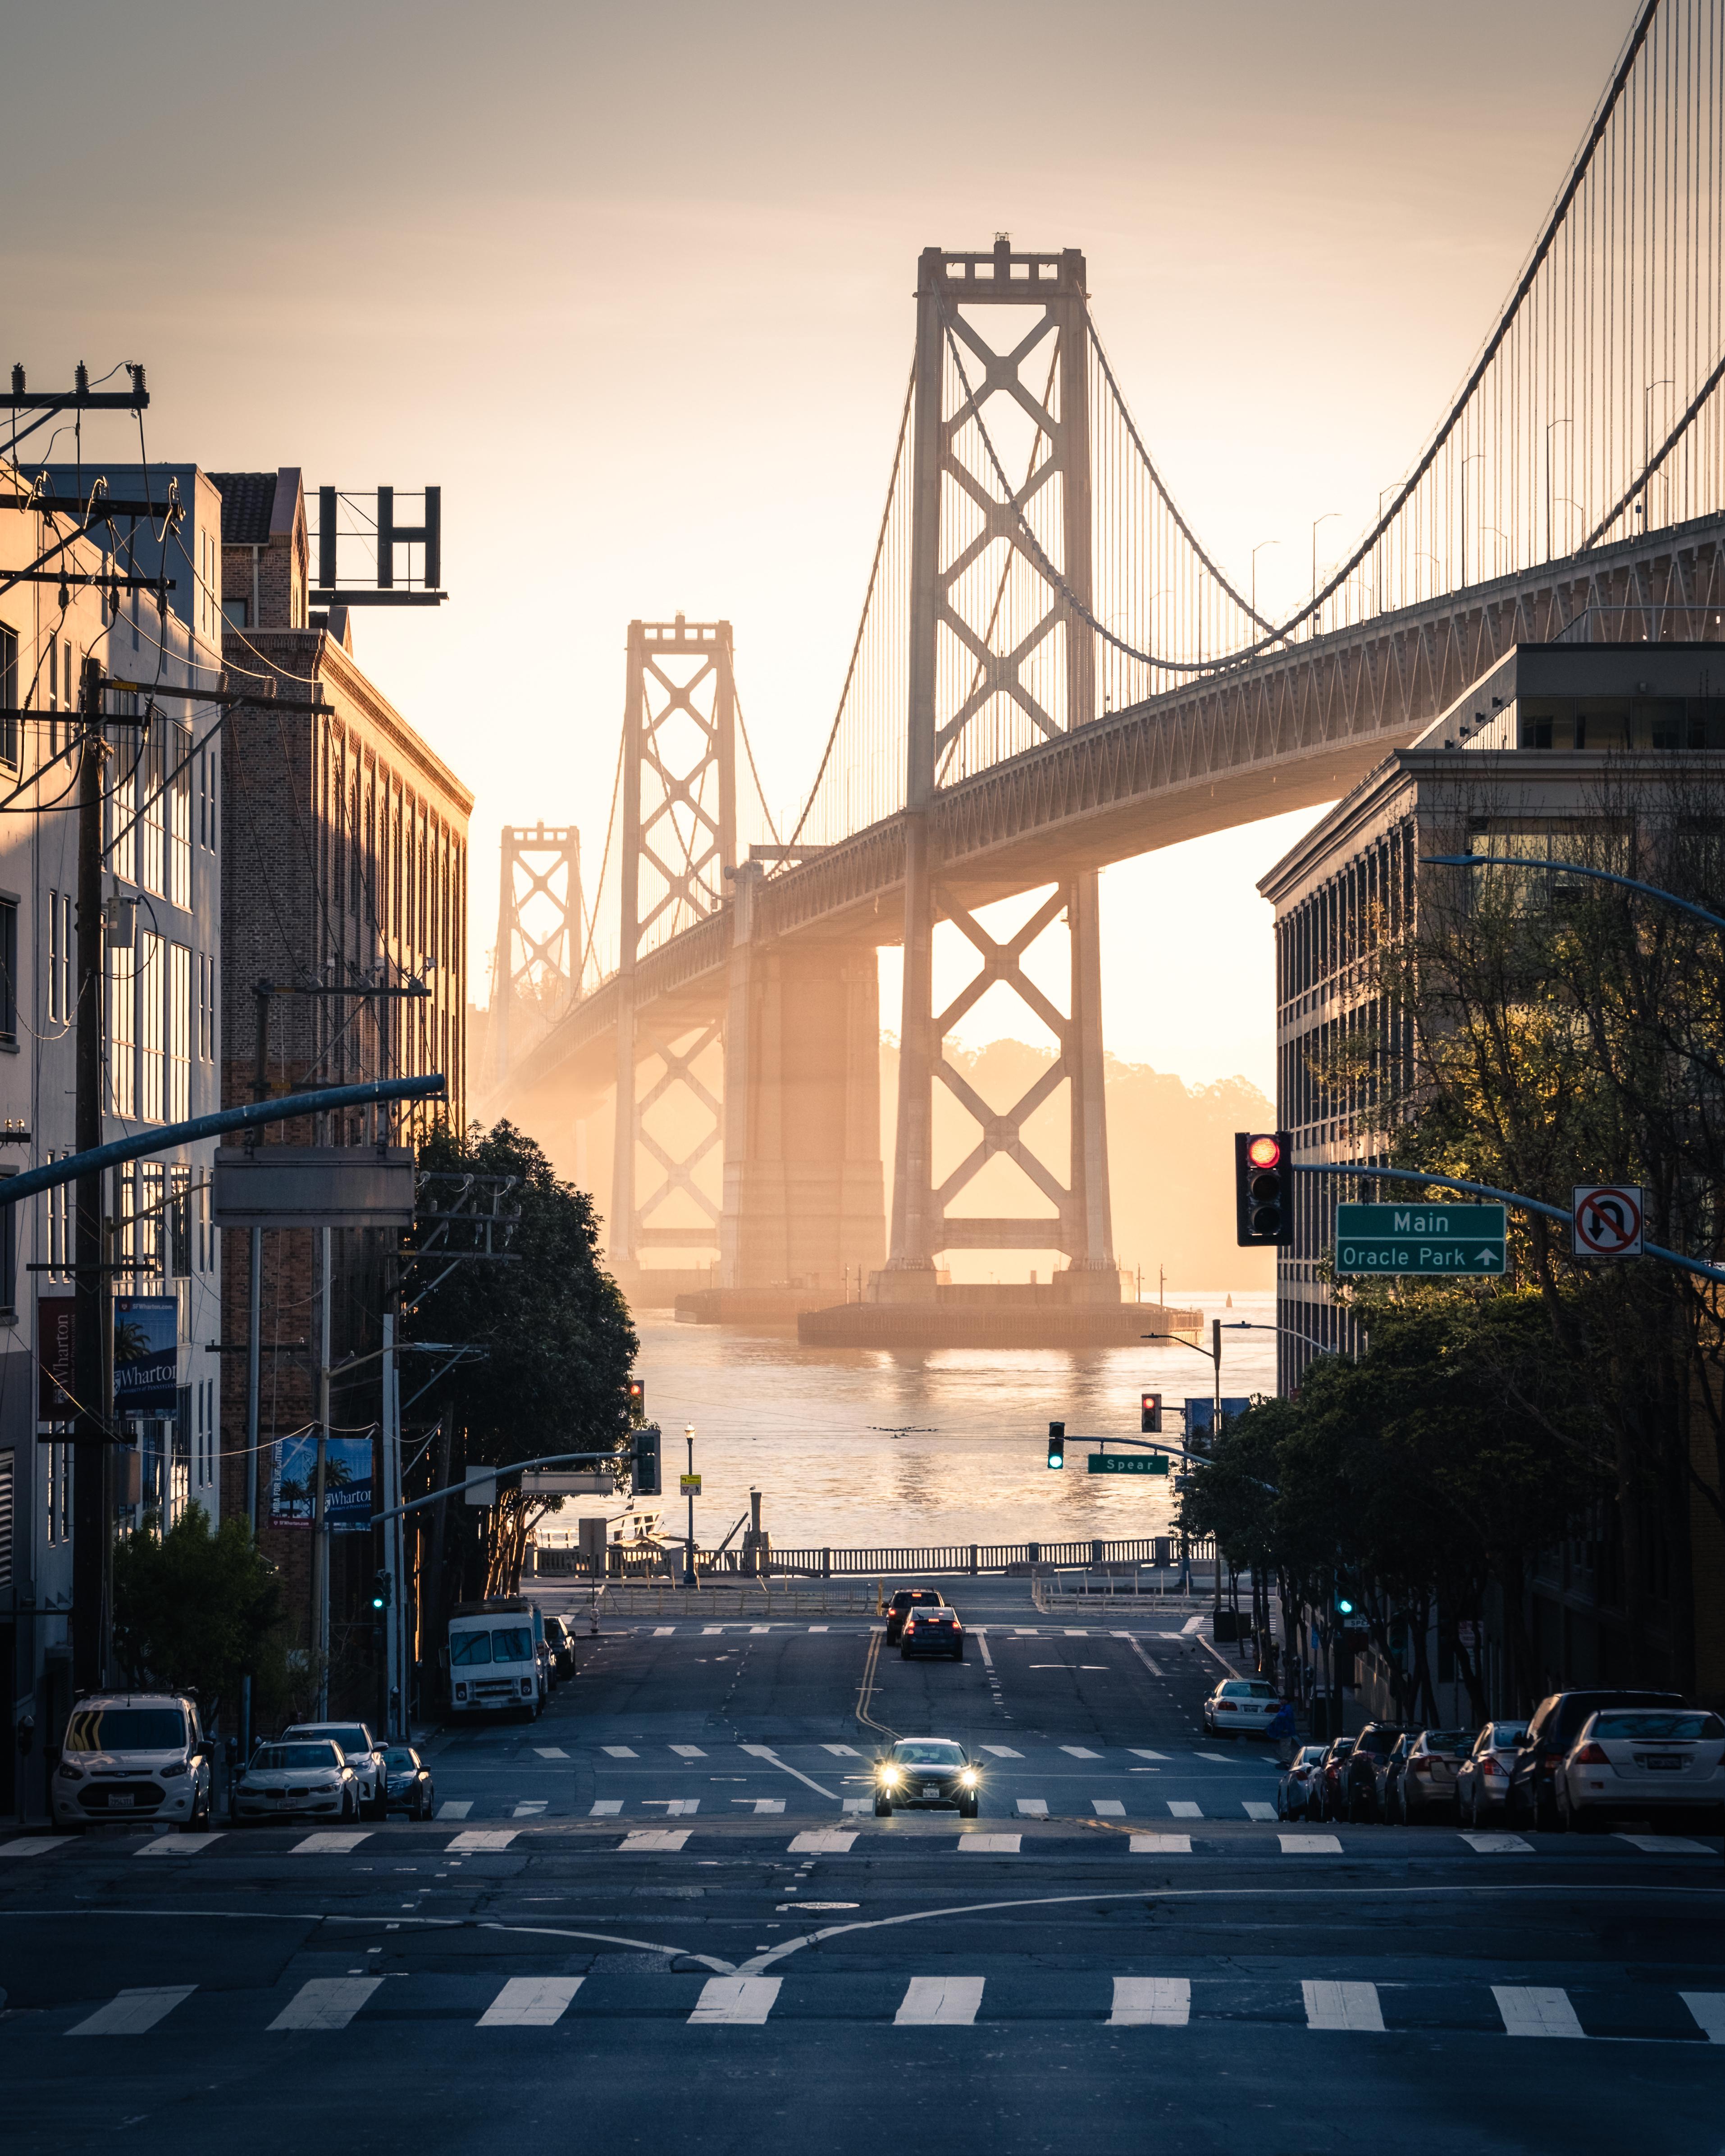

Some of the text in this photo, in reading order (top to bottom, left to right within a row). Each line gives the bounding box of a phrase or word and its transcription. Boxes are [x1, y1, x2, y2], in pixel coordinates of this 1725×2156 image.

[1394, 1211, 1448, 1232] Main
[1343, 1247, 1465, 1265] Oracle Park
[52, 1314, 68, 1388] Wharton
[1107, 1459, 1153, 1471] Spear
